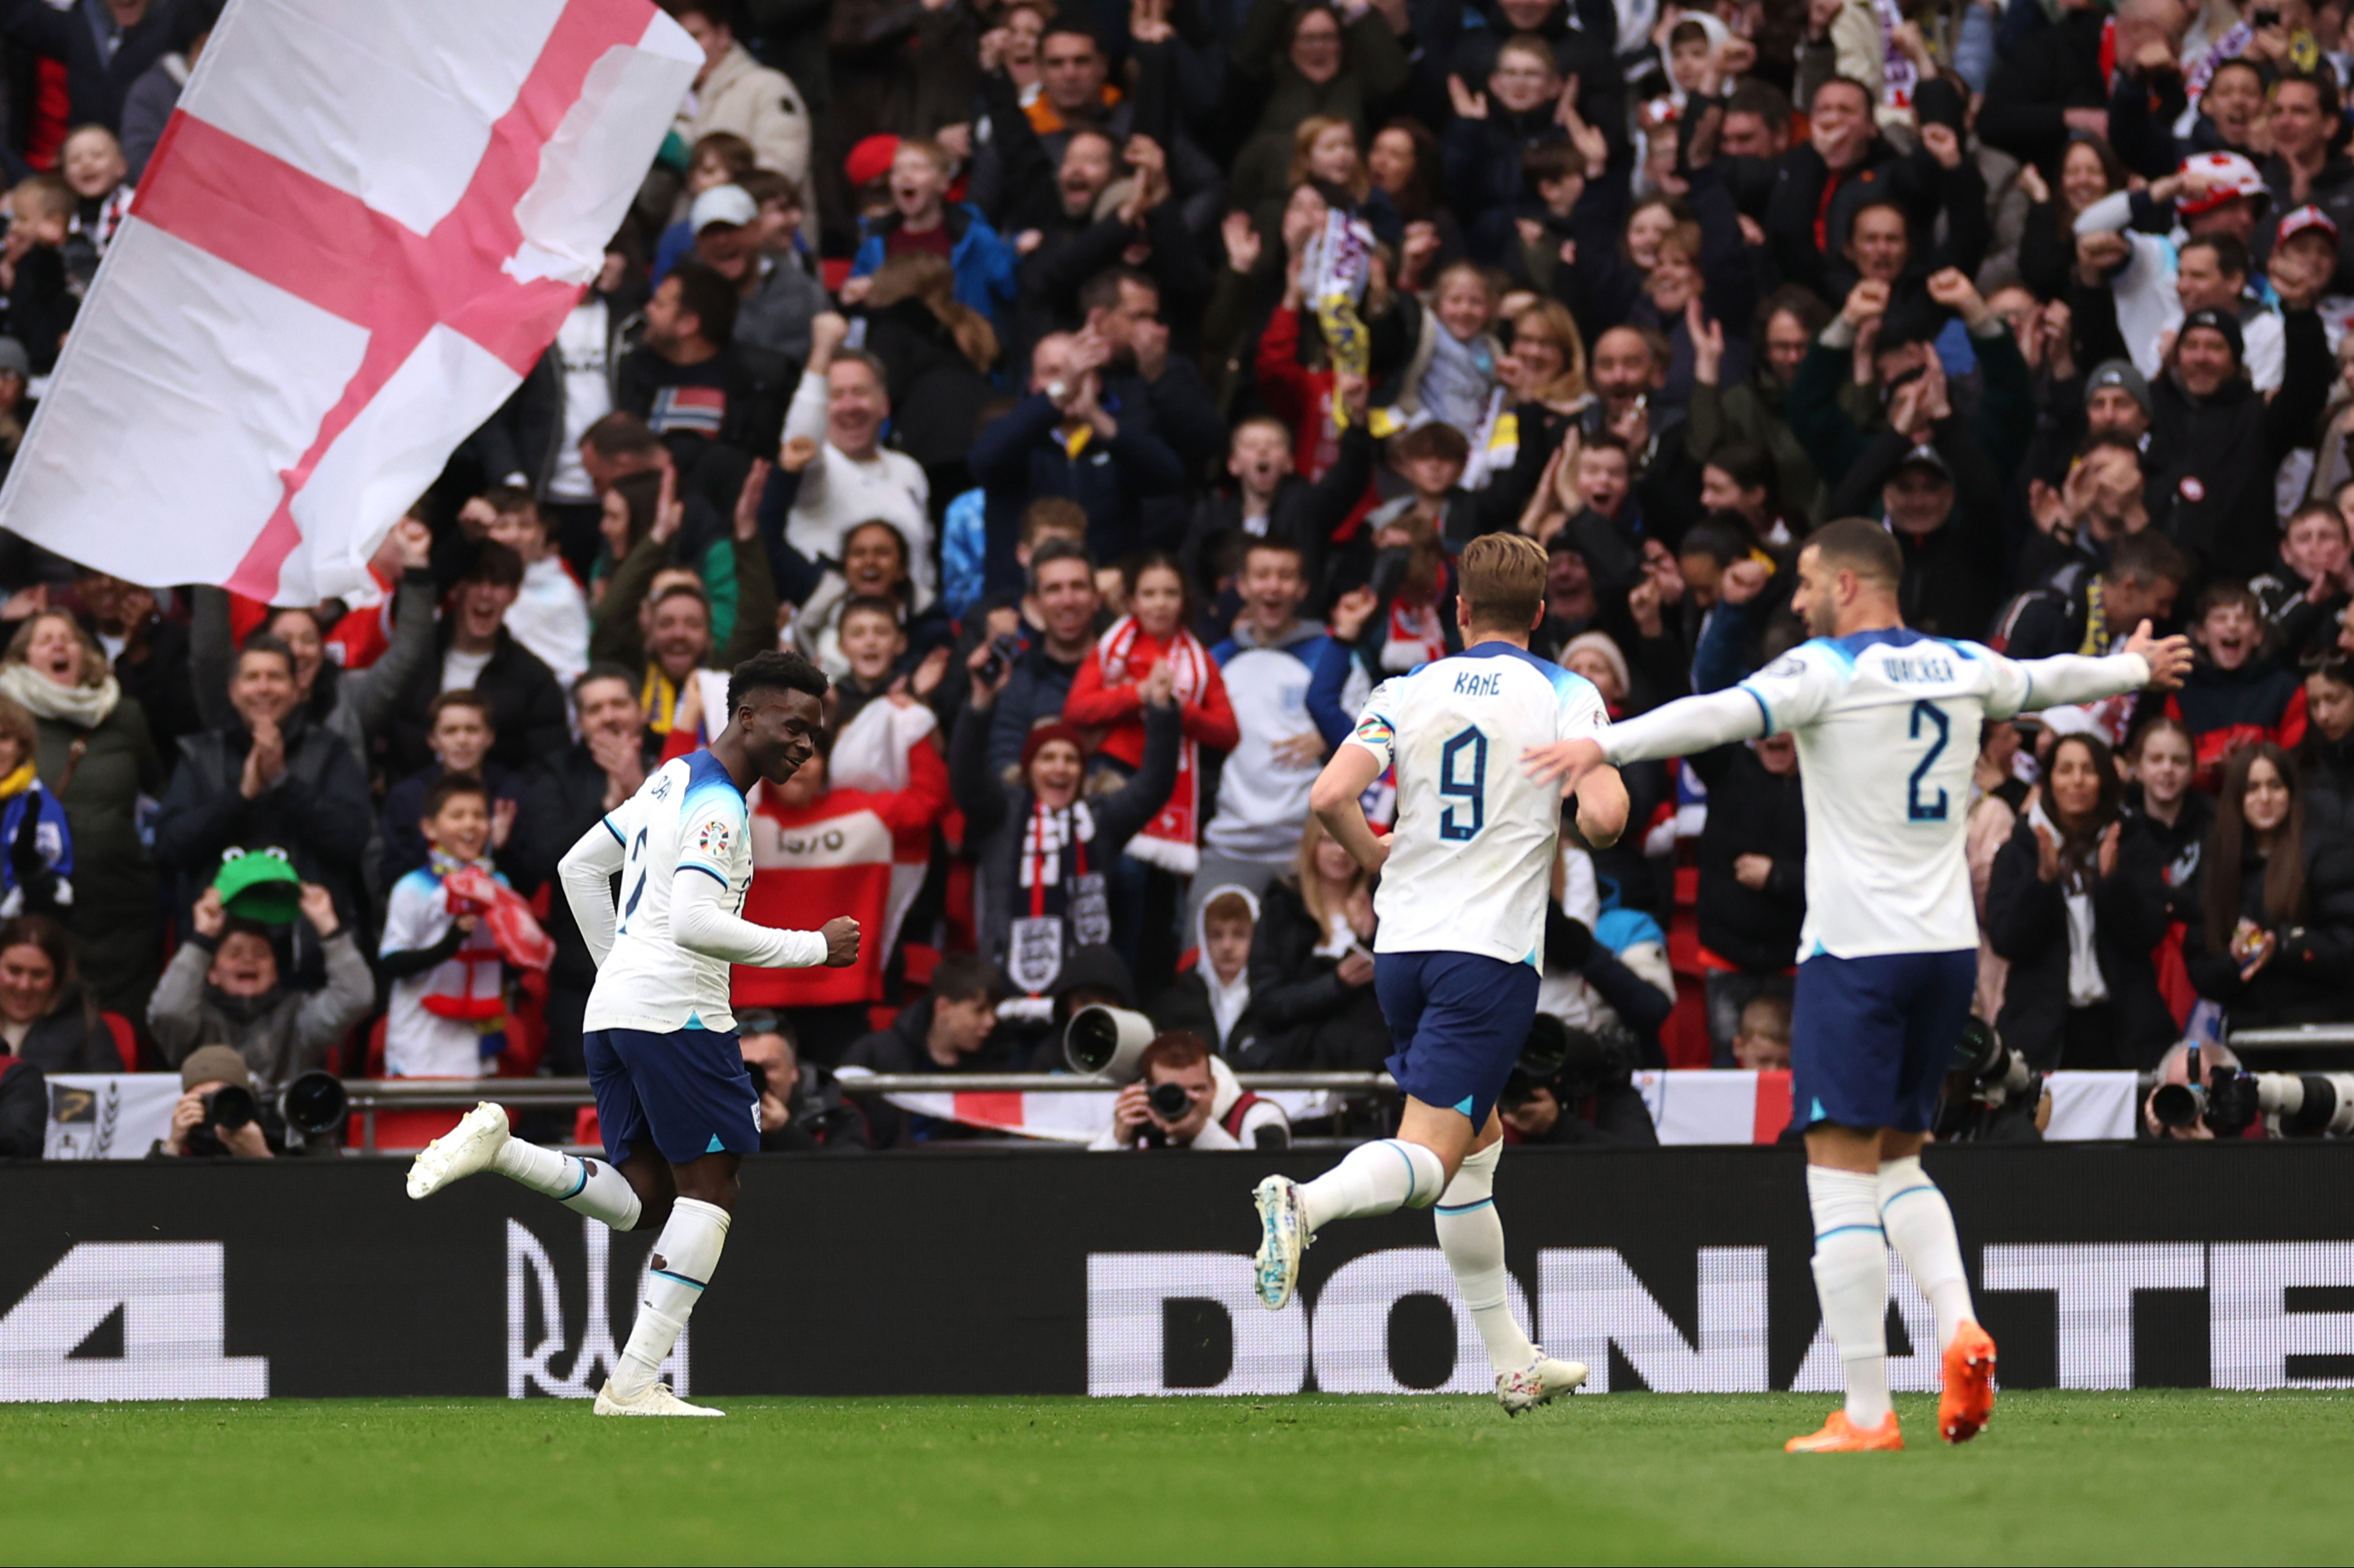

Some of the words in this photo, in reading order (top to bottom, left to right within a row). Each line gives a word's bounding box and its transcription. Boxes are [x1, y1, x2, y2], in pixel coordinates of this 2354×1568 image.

[1453, 671, 1502, 696] KANE
[1439, 723, 1488, 841] 9
[1908, 699, 1949, 822] 2
[0, 1240, 269, 1402] 4
